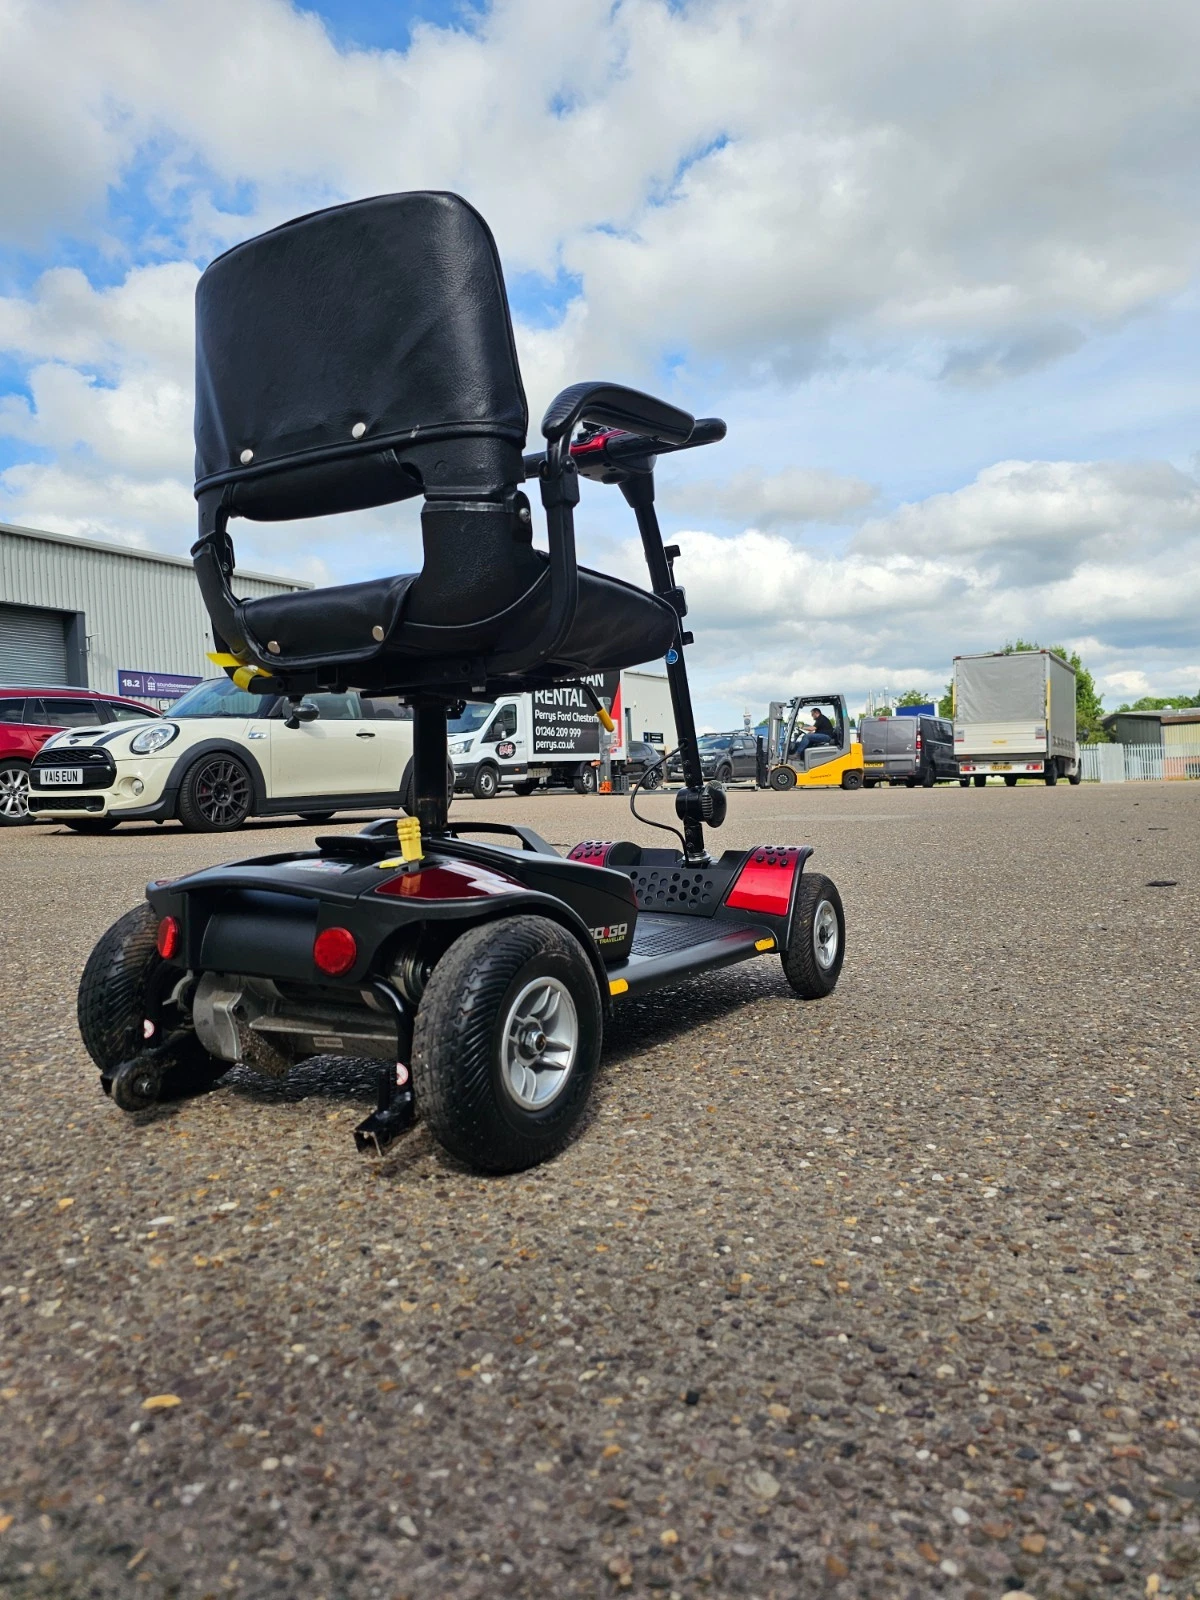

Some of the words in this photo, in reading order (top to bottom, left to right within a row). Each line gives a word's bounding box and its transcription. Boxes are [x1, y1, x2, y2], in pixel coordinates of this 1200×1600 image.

[122, 679, 140, 688] 18.2
[534, 689, 587, 707] RENTAL
[534, 709, 557, 723] Perrys
[557, 711, 572, 721] Ford
[572, 712, 599, 723] Chesterfi
[535, 726, 555, 737] 01246
[555, 727, 569, 737] 209
[569, 728, 582, 738] 999
[535, 739, 575, 751] perrys.co.uk
[44, 770, 60, 782] VA15
[61, 770, 78, 782] EUN
[599, 935, 625, 945] TRAVELLER
